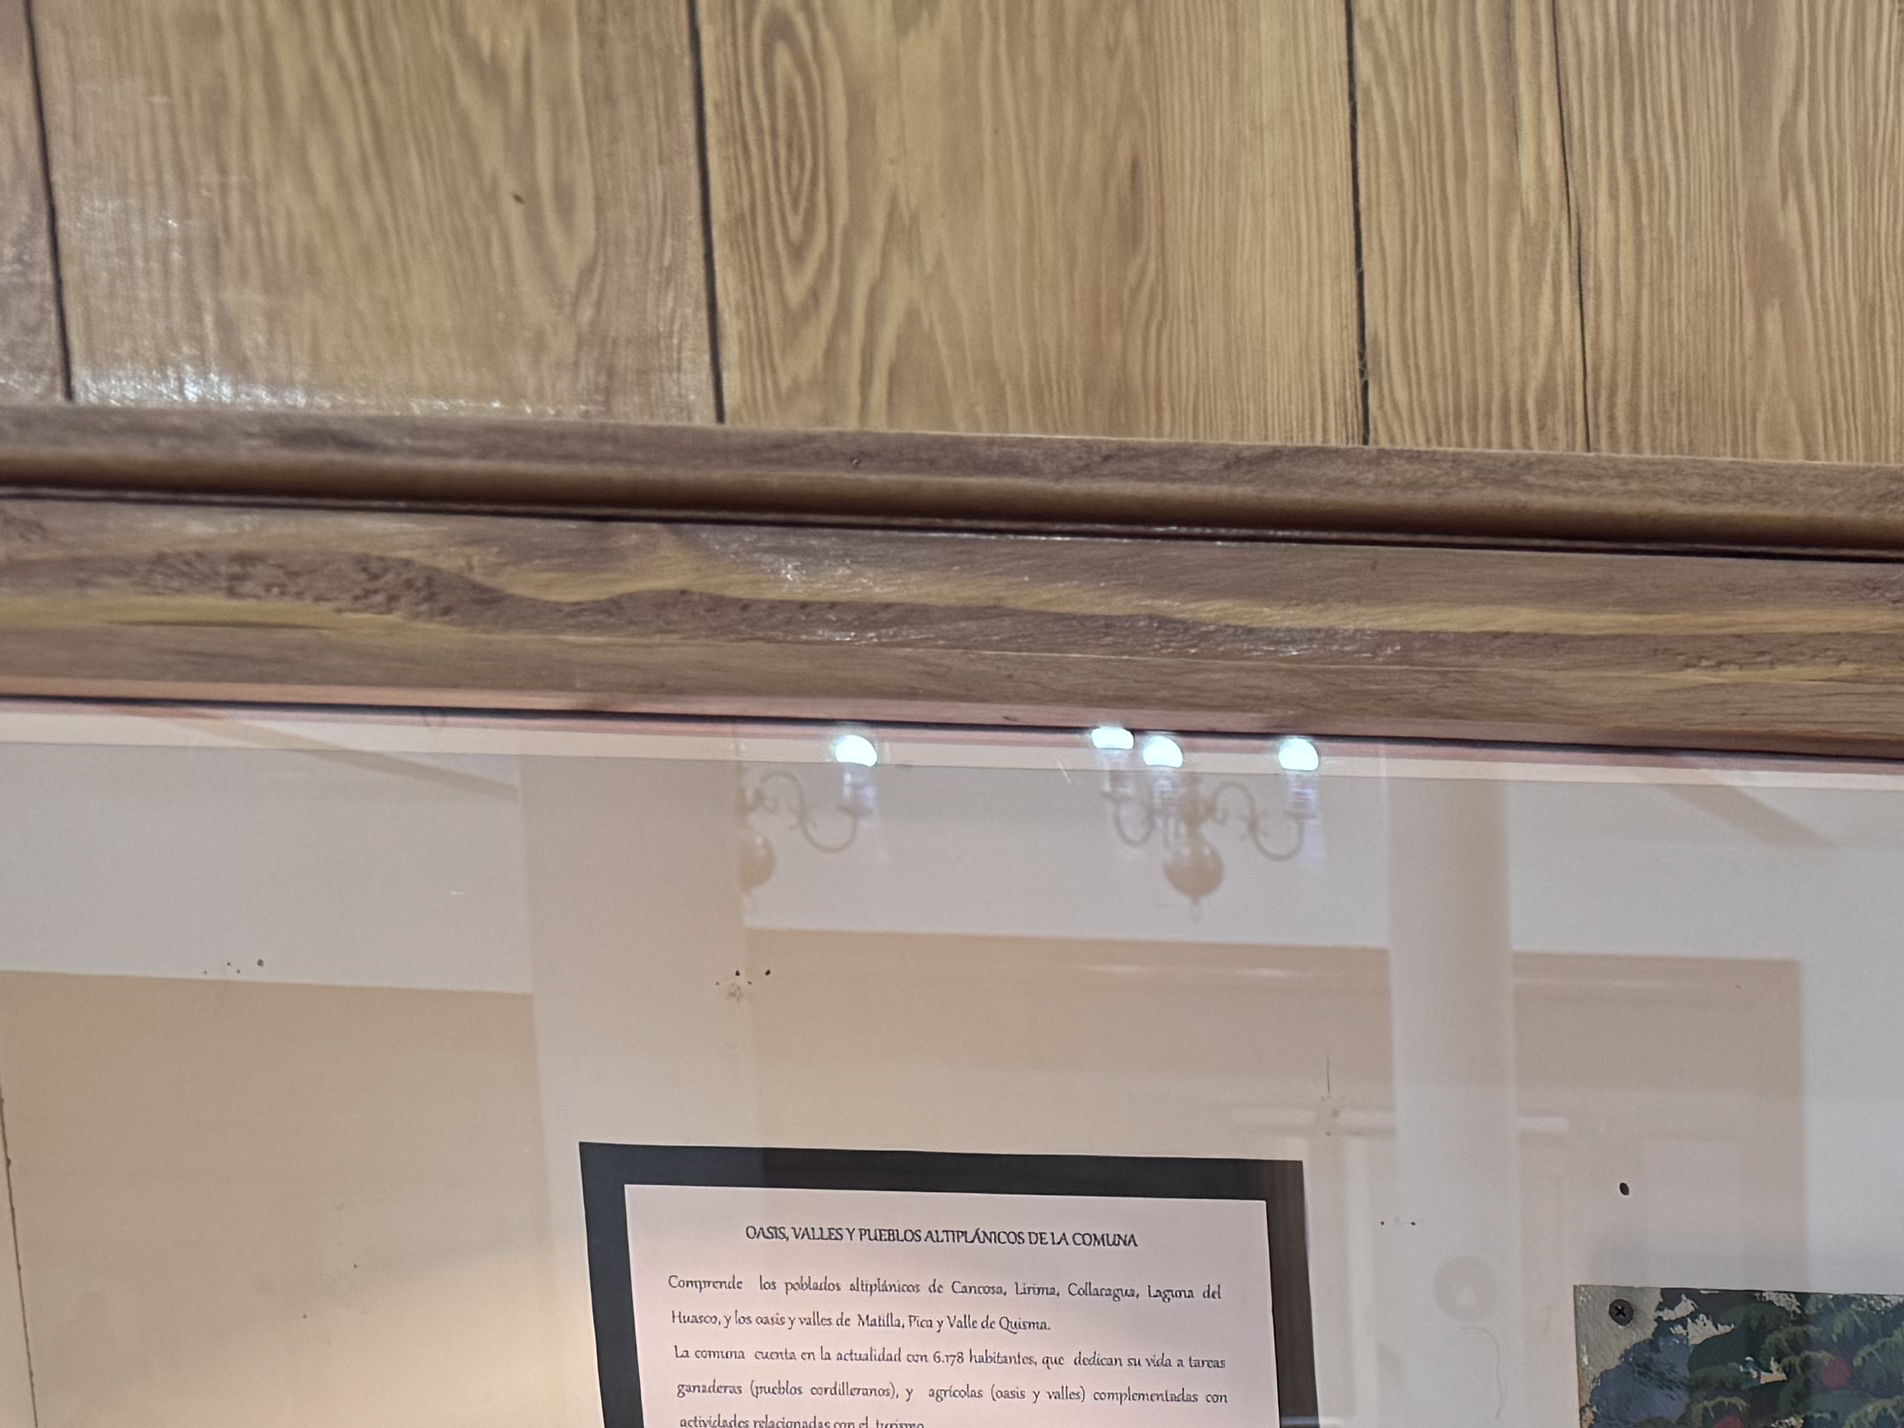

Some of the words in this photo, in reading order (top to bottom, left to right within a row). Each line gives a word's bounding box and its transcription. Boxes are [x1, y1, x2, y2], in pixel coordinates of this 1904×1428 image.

[789, 1225, 844, 1242] VALLES
[843, 1226, 856, 1242] Y
[856, 1226, 922, 1243] PUEBLOS
[922, 1226, 1026, 1245] ALTIPLÁNICOS
[1026, 1230, 1049, 1246] DE
[1049, 1230, 1070, 1246] LA
[1070, 1231, 1139, 1248] COMUNA
[666, 1273, 743, 1293] Comprende
[758, 1273, 777, 1291] los
[783, 1274, 842, 1296] poblados
[848, 1275, 921, 1297] altiplánicos
[926, 1277, 944, 1294] de
[950, 1279, 1007, 1297] Cancosa,
[1146, 1283, 1195, 1304] Laguna
[1201, 1282, 1222, 1300] del
[722, 1314, 732, 1329] y
[733, 1308, 753, 1325] los
[754, 1311, 786, 1326] oasis
[786, 1315, 796, 1331] y
[797, 1309, 833, 1327] valles
[834, 1310, 851, 1327] de
[906, 1313, 934, 1329] Pica
[935, 1318, 944, 1334] y
[945, 1312, 978, 1329] Valle
[979, 1313, 996, 1330] de
[672, 1343, 691, 1359] La
[693, 1348, 746, 1360] comuna
[753, 1346, 797, 1361] cuenta
[799, 1350, 816, 1361] en
[819, 1344, 832, 1361] la
[835, 1345, 902, 1363] actualidad
[905, 1352, 929, 1363] con
[931, 1349, 965, 1367] 6.178
[1040, 1354, 1065, 1370] que
[1072, 1349, 1124, 1367] dedican
[1126, 1356, 1142, 1368] su
[1144, 1351, 1173, 1368] vida
[1175, 1357, 1185, 1368] a
[1187, 1354, 1226, 1369] tareas
[675, 1377, 743, 1399] ganaderas
[748, 1378, 804, 1399] (pueblos
[904, 1387, 914, 1402] y
[927, 1382, 984, 1403] agrícolas
[989, 1382, 1026, 1402] (oasis
[1030, 1389, 1041, 1404] y
[1092, 1384, 1199, 1406] complementadas
[1204, 1392, 1228, 1404] con
[678, 1412, 750, 1428] actividades
